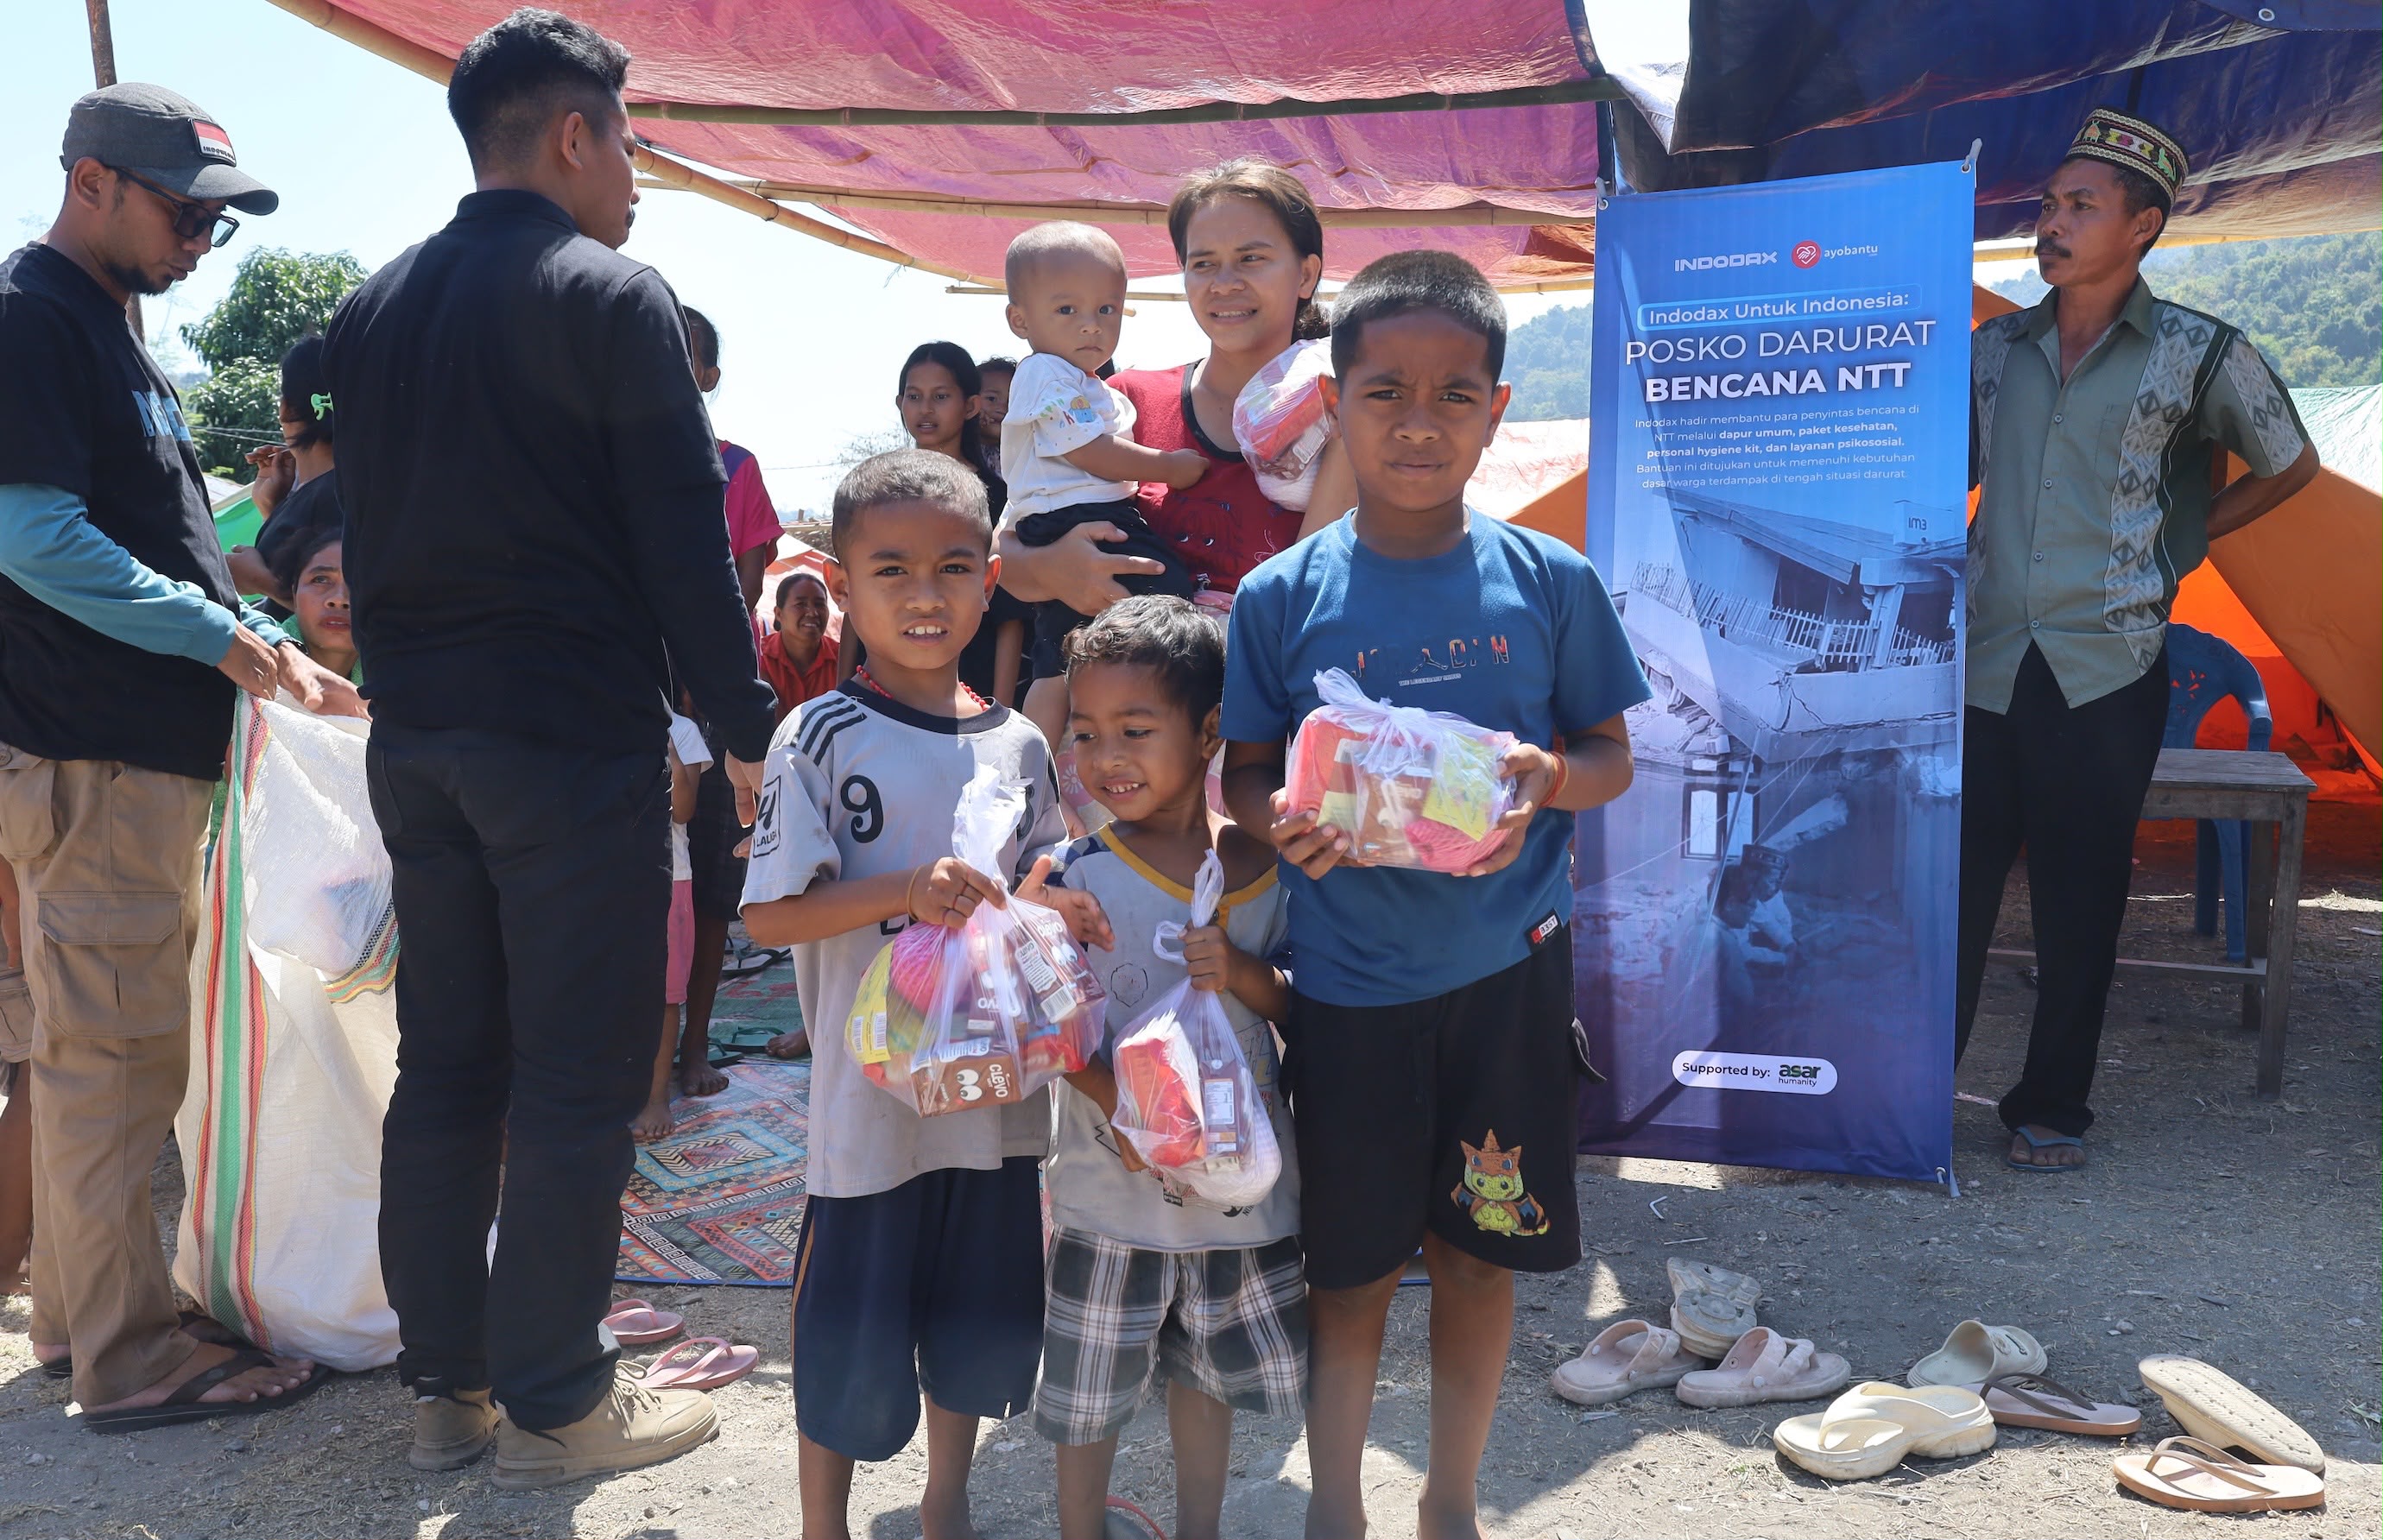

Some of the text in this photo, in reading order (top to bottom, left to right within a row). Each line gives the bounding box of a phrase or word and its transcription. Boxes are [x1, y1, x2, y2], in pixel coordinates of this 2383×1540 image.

[1674, 251, 1778, 272] INDODAX
[1824, 245, 1878, 259] ayobantu
[1650, 292, 1909, 325] Indodax Untuk Indonesia:
[1625, 320, 1937, 365] POSKO DARURAT
[1646, 362, 1912, 402] BENCANA NTT
[1635, 404, 1919, 428] Indodax hadir membantu para penyintas bencana di
[1654, 421, 1898, 442] NTT melalui dapur umum, paket kesehatan,
[1647, 437, 1905, 459] personal hygiene kit, dan layanan psikososial.
[1636, 453, 1915, 474] Bantuan ini ditujukan untuk memenuhi kebutuhan
[1642, 479, 1670, 489] dasar
[1672, 478, 1706, 489] warga
[1709, 475, 1768, 487] terdampak
[1771, 474, 1781, 483] di
[1784, 472, 1823, 484] tengah
[1826, 469, 1861, 480] situasi
[840, 774, 884, 843] 9
[1682, 1062, 1770, 1079] Supported by:
[1779, 1063, 1822, 1079] asar
[1779, 1078, 1817, 1087] humanity
